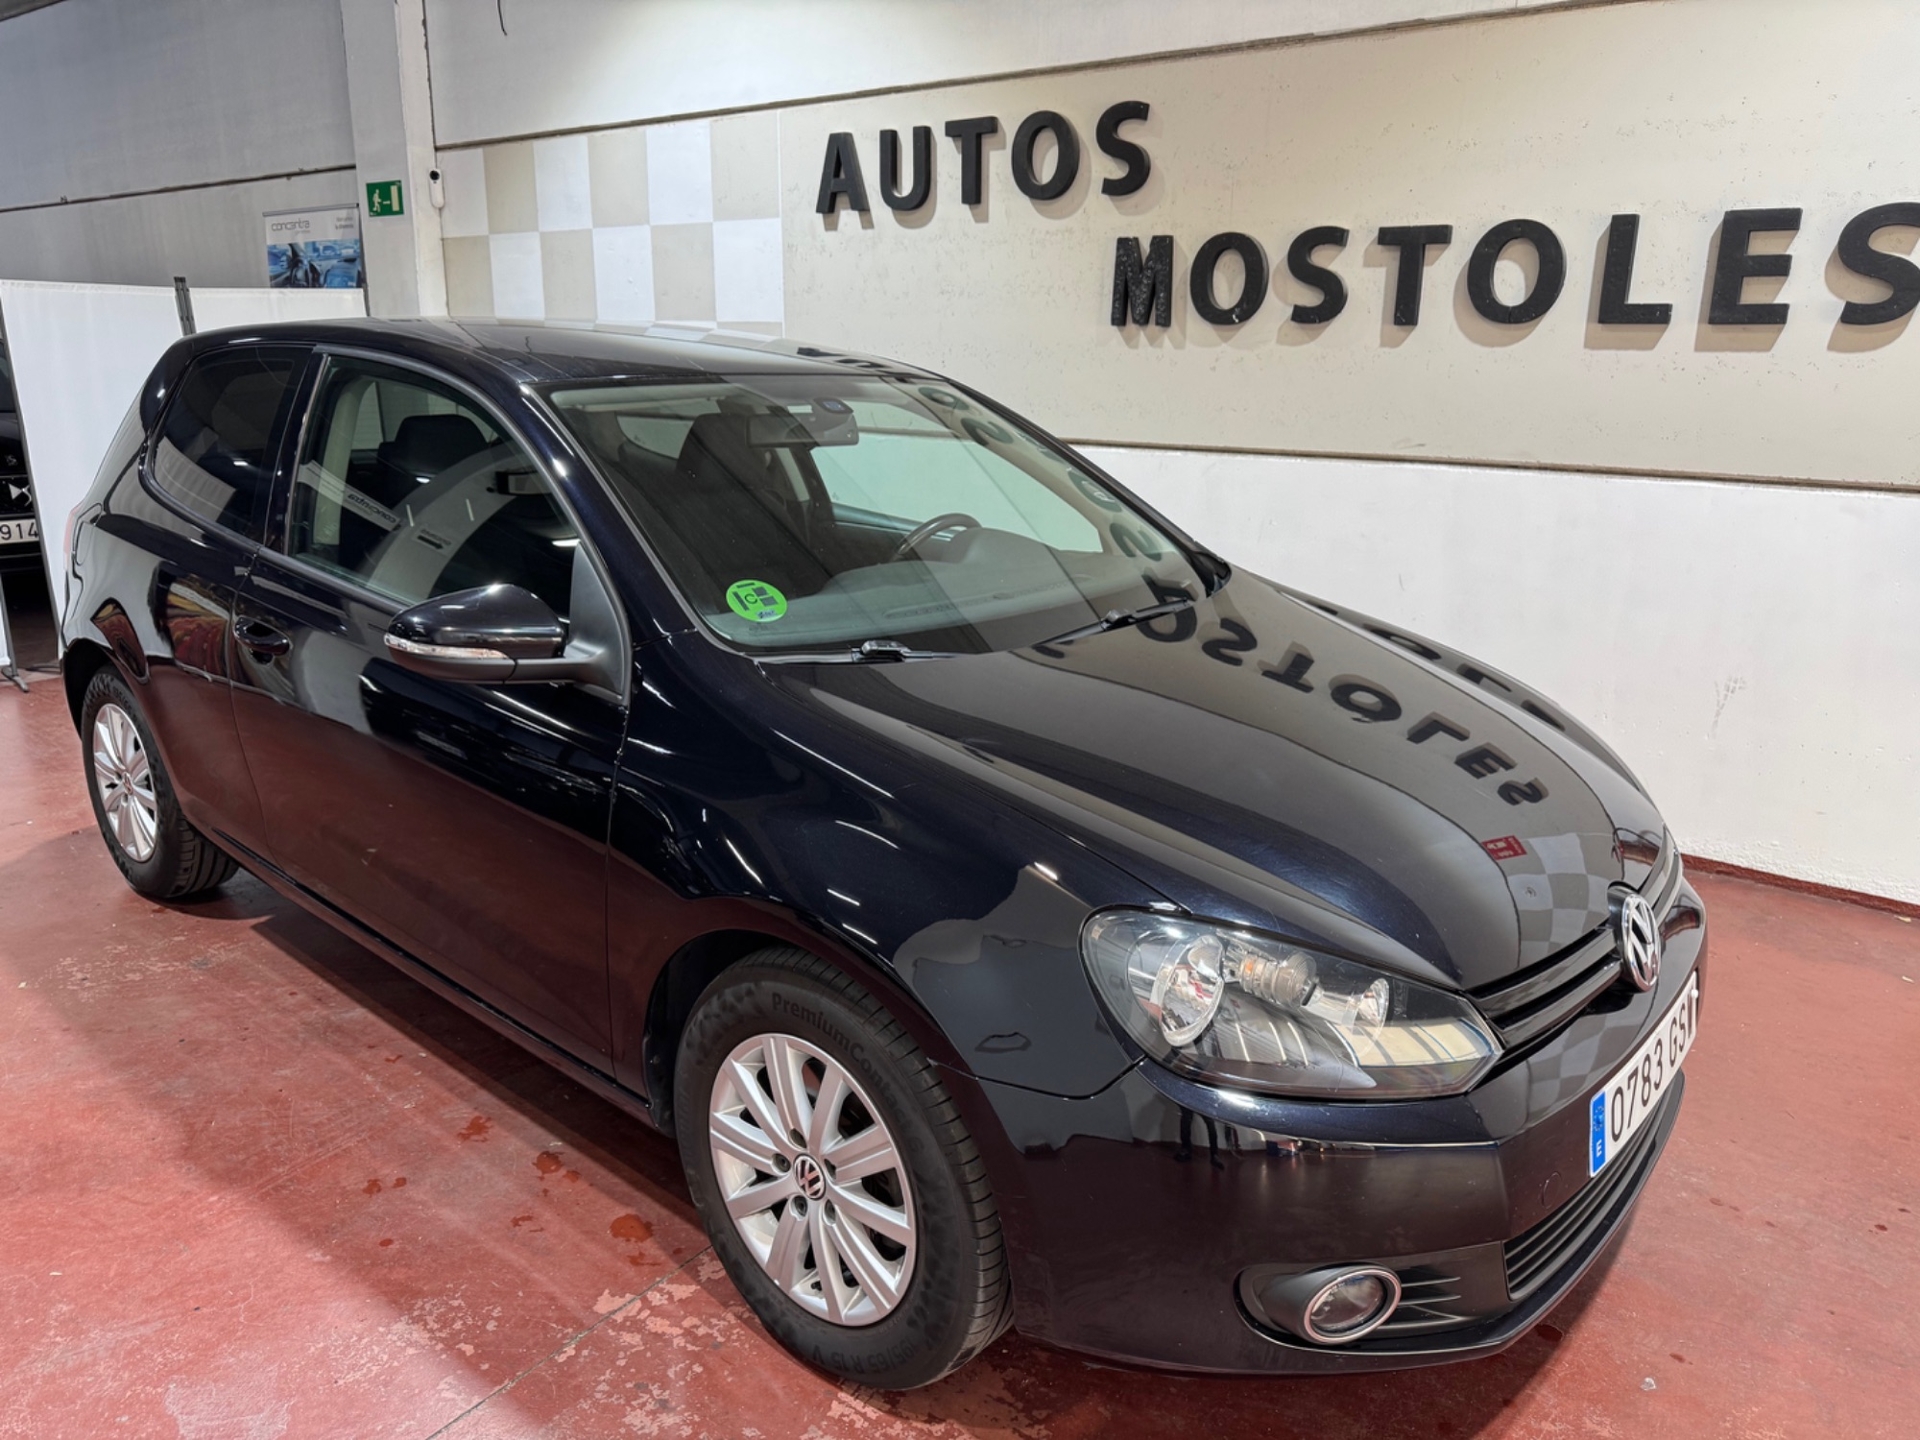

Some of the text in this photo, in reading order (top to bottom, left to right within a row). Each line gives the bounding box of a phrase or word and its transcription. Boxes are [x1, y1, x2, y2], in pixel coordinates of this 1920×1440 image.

[815, 100, 1151, 215] AUTOS
[1110, 202, 1920, 328] MOSTOLES
[0, 522, 39, 541] 914
[772, 993, 912, 1131] PremiumContact
[1611, 1038, 1663, 1142] 0783
